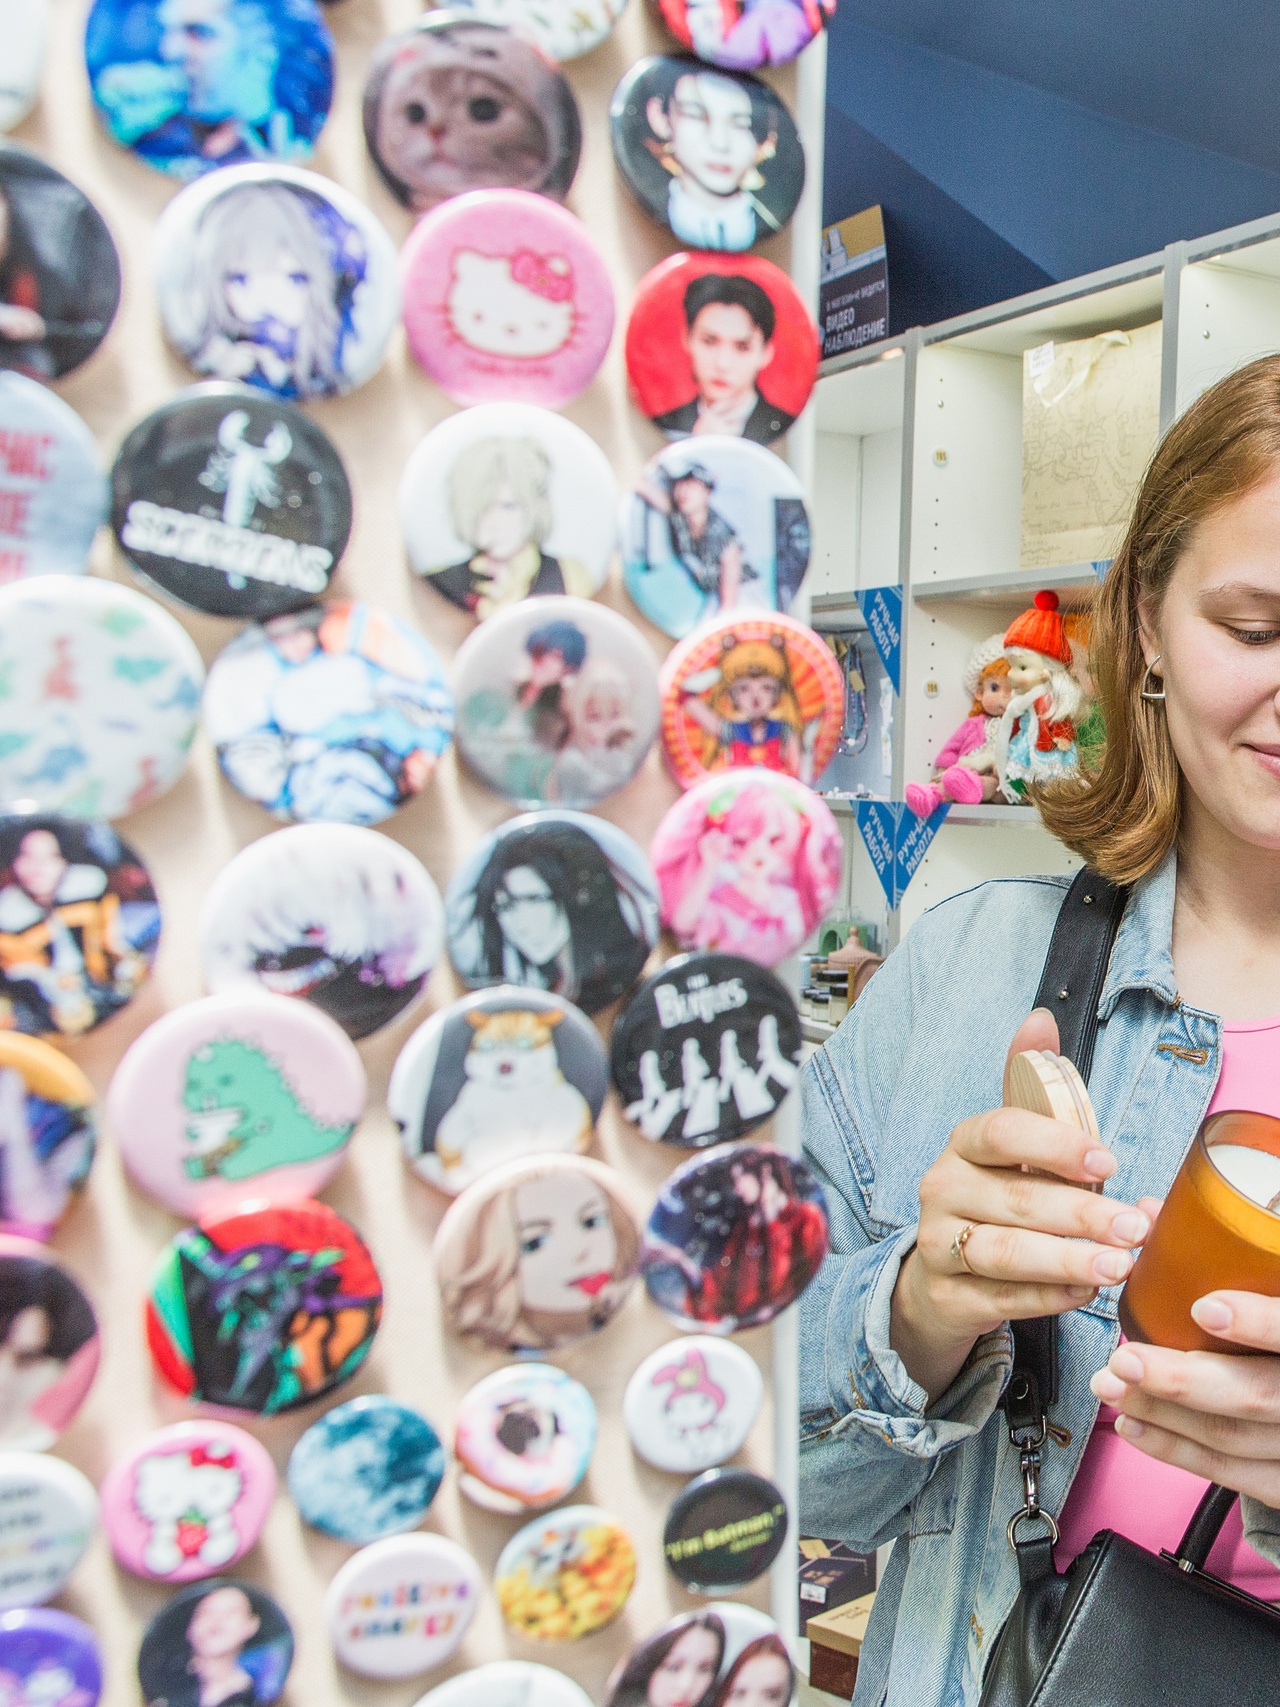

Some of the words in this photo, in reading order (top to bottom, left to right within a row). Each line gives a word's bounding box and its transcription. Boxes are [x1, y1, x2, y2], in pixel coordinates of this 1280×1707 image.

[824, 317, 886, 356] НАБЛЮДЕНИЕ
[826, 307, 855, 334] ВИДЕО
[869, 608, 892, 661] РАБОТА
[862, 821, 886, 876] РАБОТА
[905, 826, 934, 877] РАБОТА
